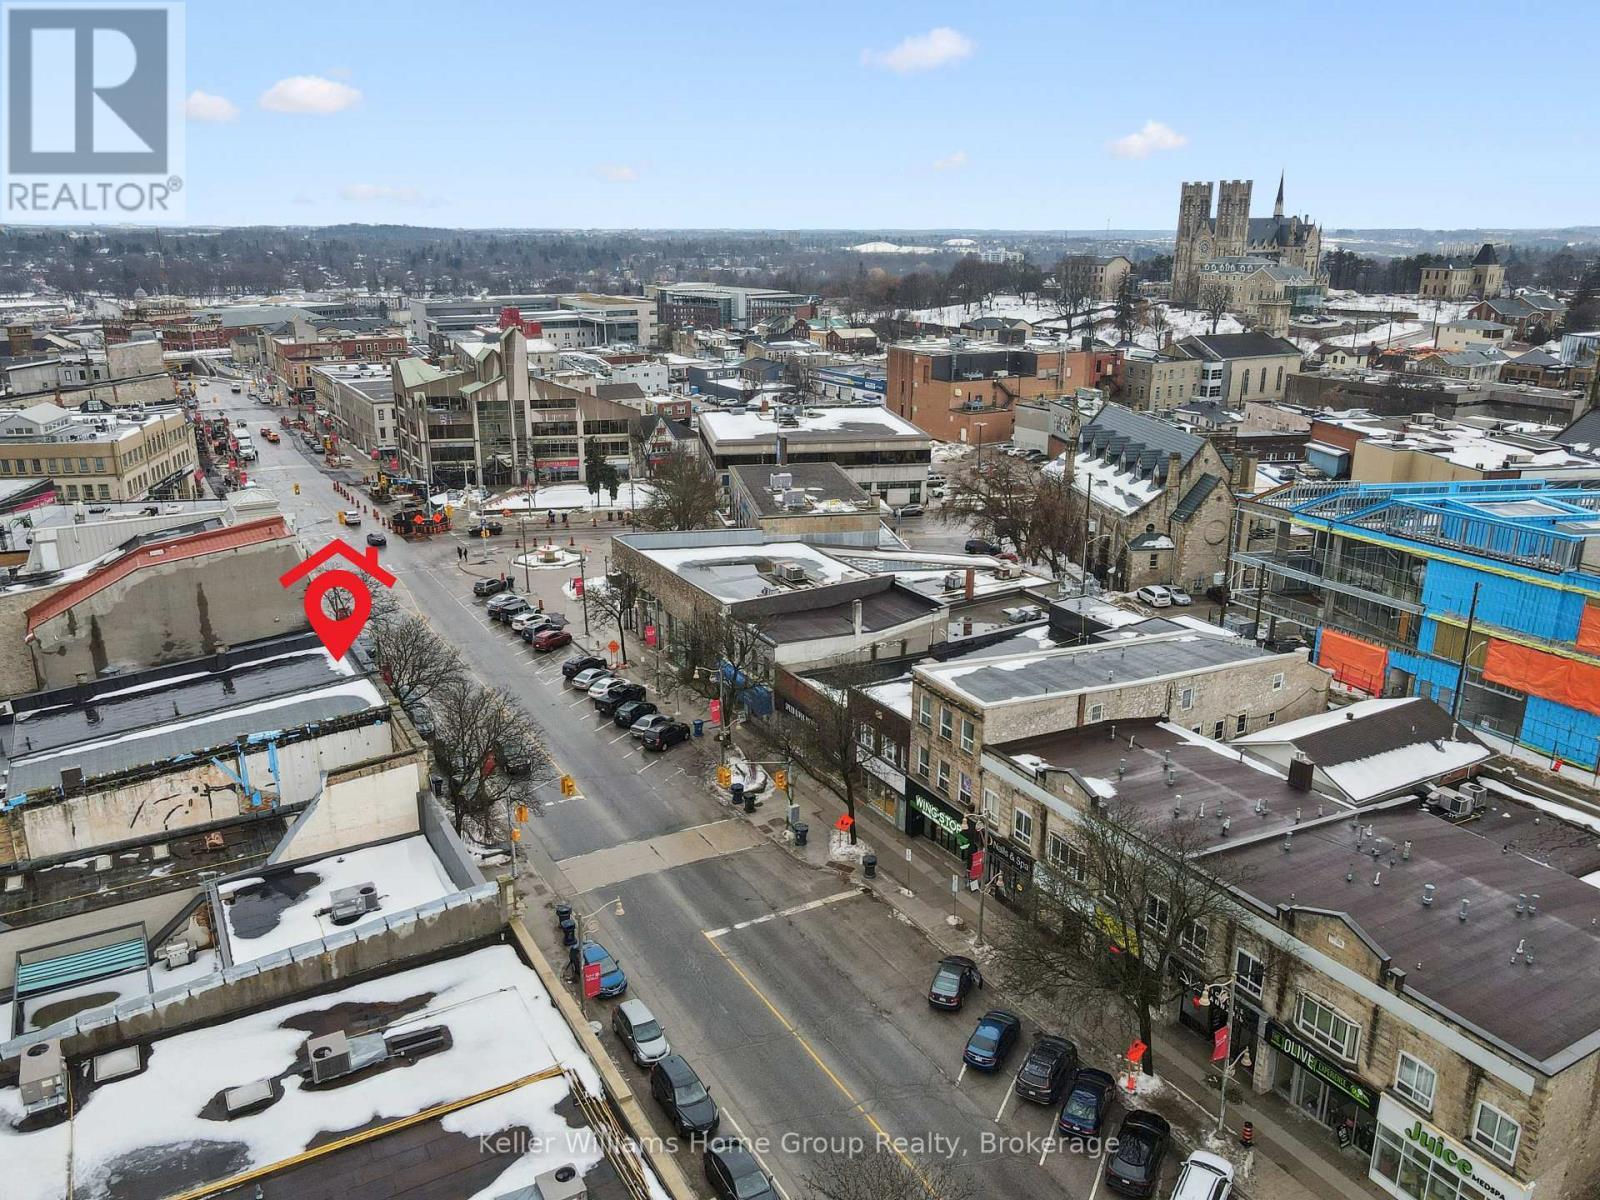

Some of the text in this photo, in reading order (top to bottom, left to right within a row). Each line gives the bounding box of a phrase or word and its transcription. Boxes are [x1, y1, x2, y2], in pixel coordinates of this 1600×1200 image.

[1016, 856, 1029, 872] Spa
[1284, 1038, 1315, 1070] OLIVE
[1318, 1061, 1346, 1088] EXPERIENCE
[1404, 1121, 1506, 1200] Juice MEDSPA
